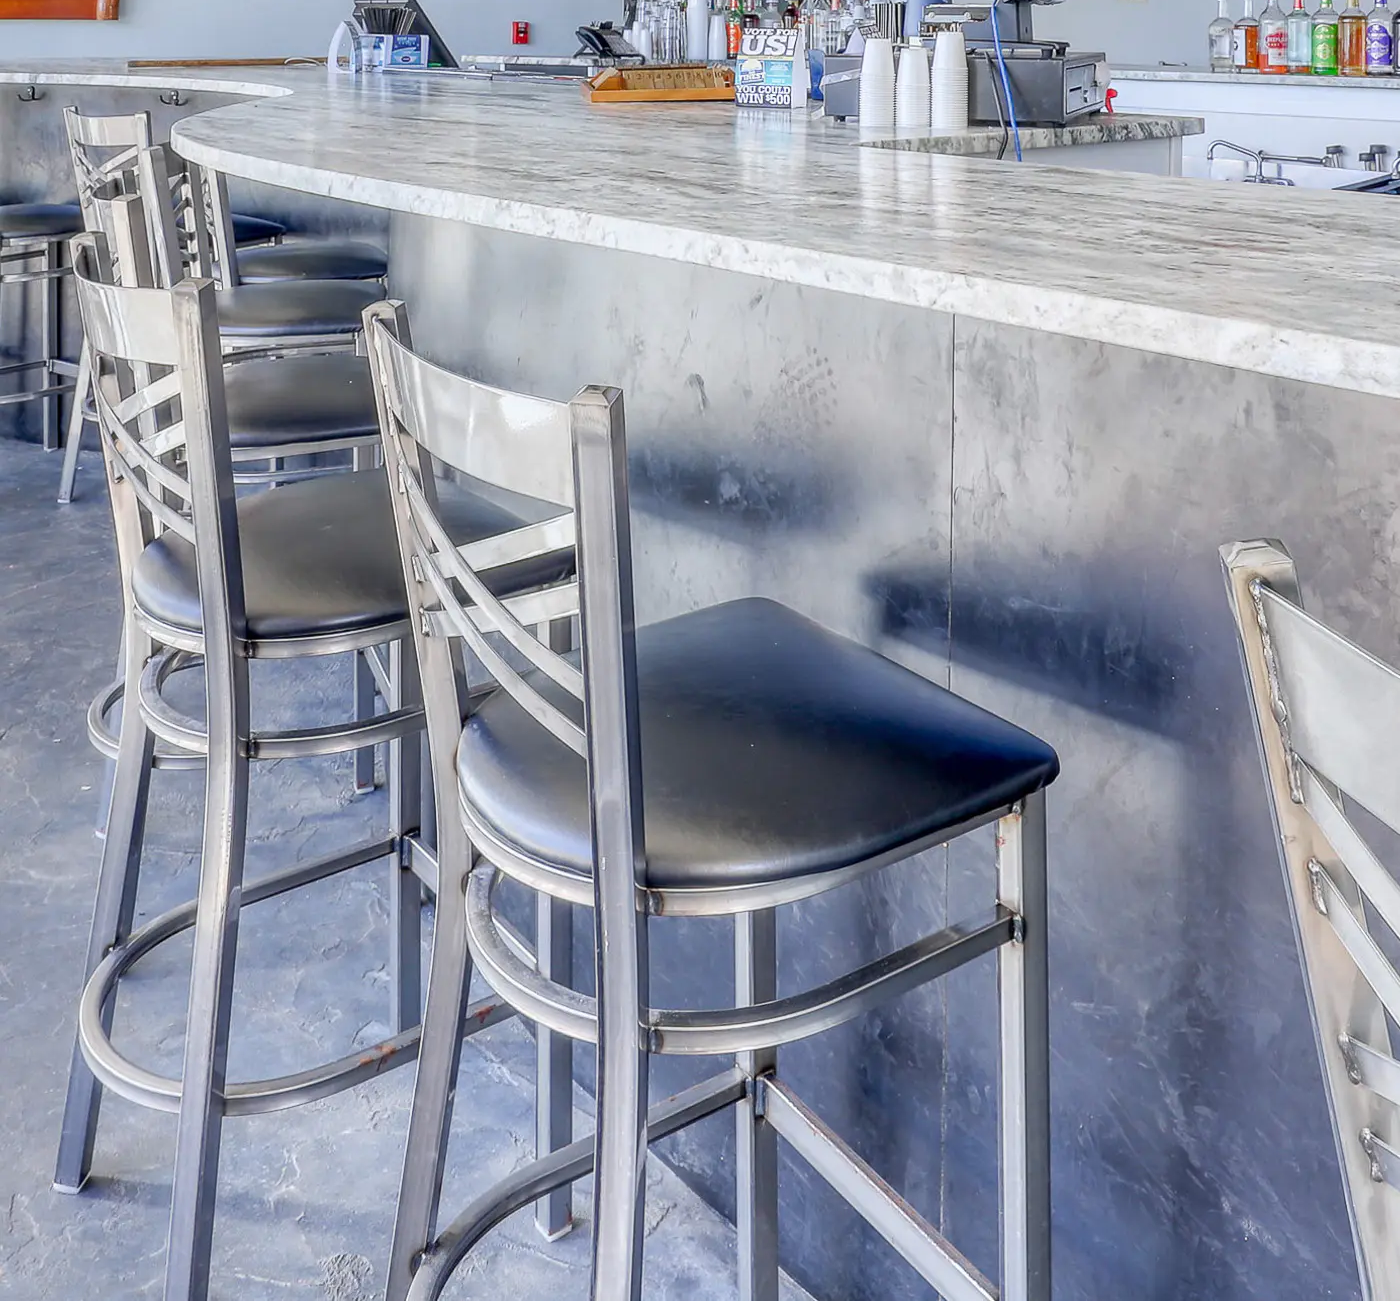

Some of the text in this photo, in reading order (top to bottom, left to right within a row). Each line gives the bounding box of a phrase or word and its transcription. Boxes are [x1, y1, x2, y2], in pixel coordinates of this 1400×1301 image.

[744, 28, 798, 36] VOTE FOR
[742, 35, 797, 56] US!
[736, 85, 791, 94] YOU COULD
[735, 93, 791, 105] WIN $500
